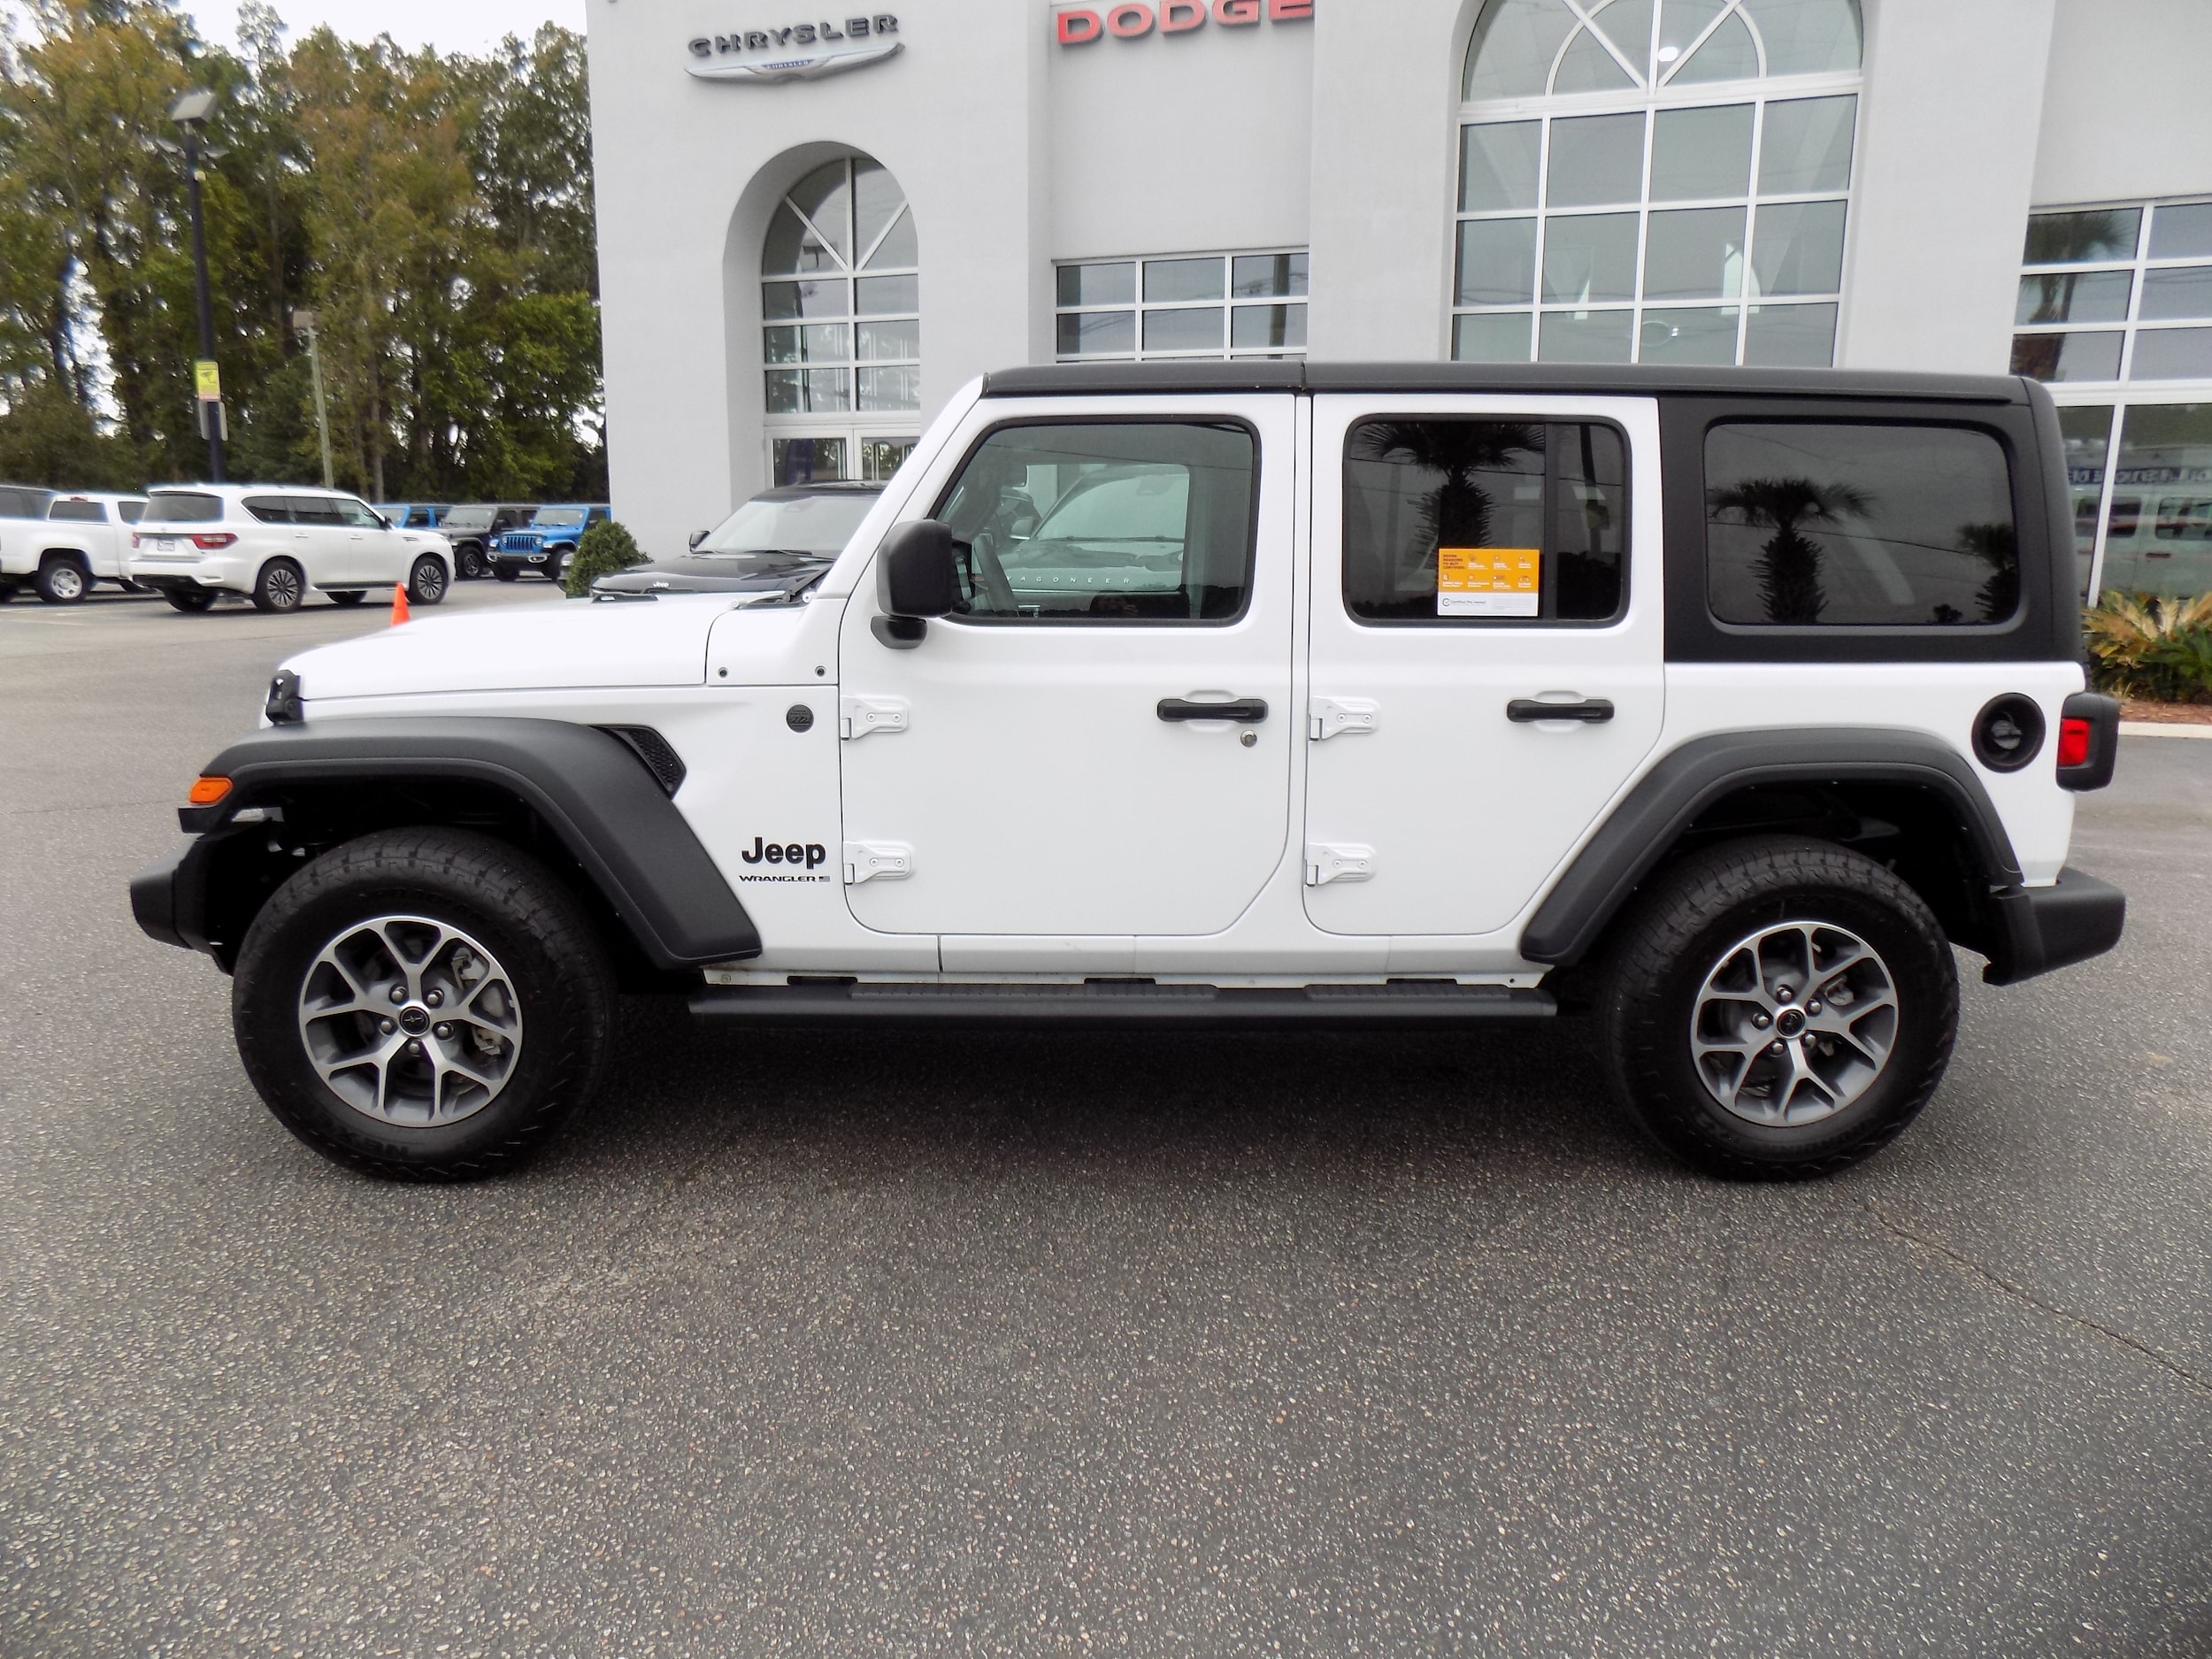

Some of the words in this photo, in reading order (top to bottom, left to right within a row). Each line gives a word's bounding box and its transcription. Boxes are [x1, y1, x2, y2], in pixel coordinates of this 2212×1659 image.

[687, 14, 898, 57] CHRYSLER
[1057, 0, 1311, 45] DODGE
[766, 59, 809, 70] CHRYSLER
[741, 836, 826, 869] Jeep
